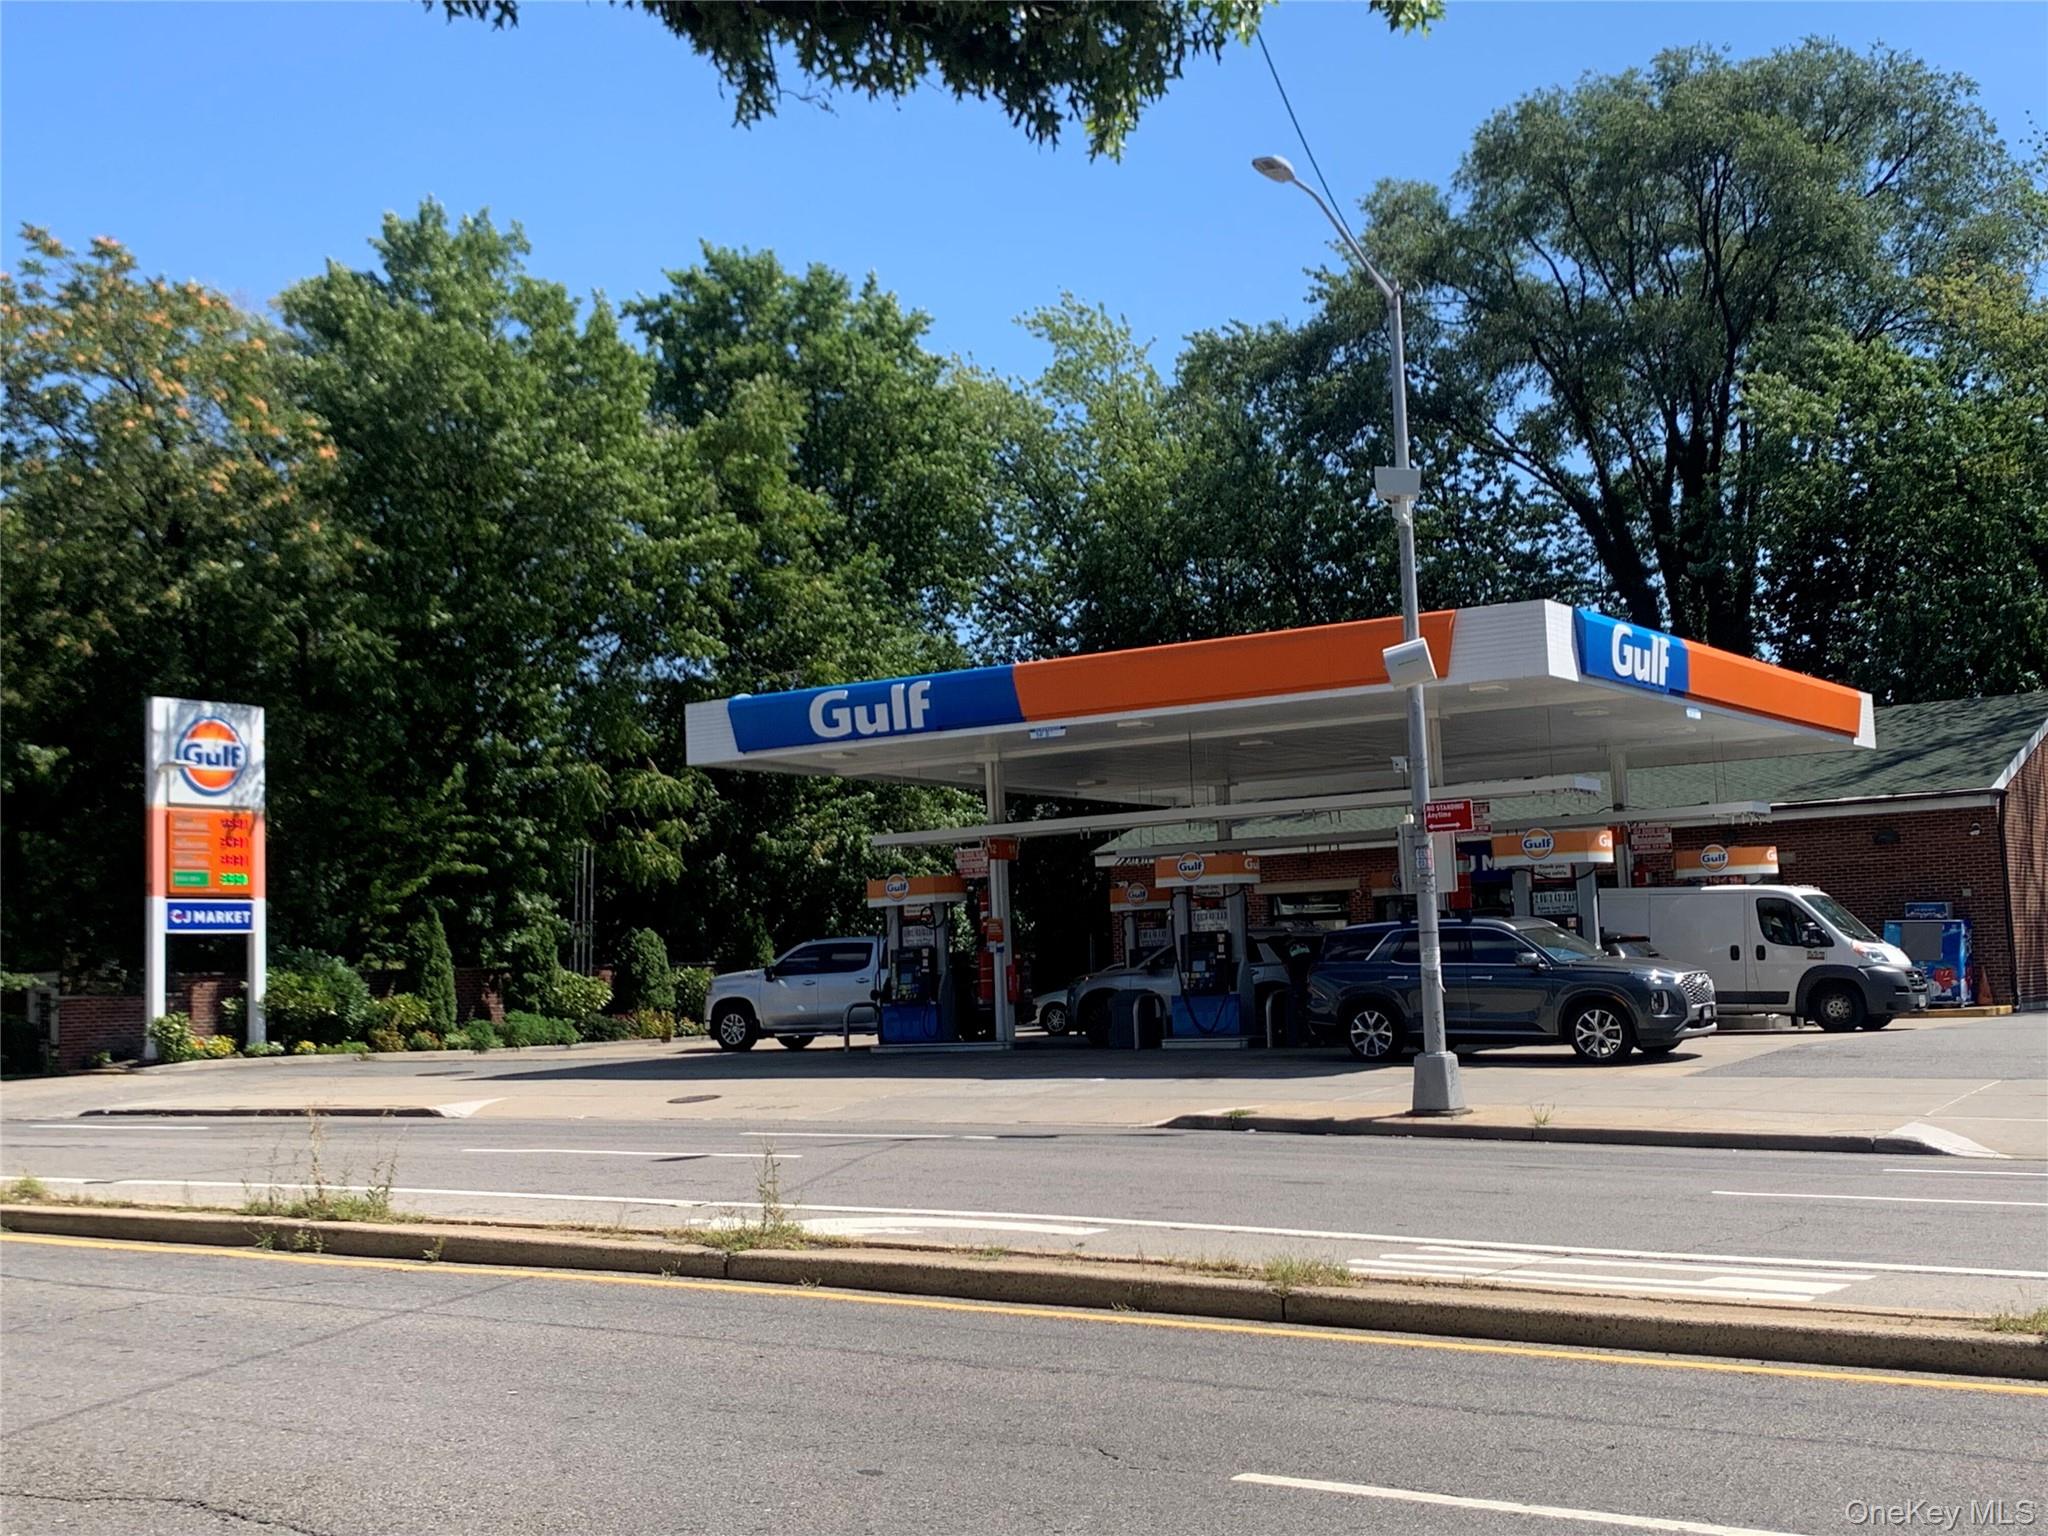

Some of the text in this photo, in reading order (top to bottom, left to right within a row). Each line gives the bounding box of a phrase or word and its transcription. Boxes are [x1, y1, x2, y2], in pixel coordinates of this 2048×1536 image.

[1611, 624, 1671, 687] Gulf
[808, 680, 931, 738] Gulf
[184, 743, 241, 767] Gulf
[1426, 804, 1435, 812] NO
[1436, 802, 1465, 811] STANDING
[1523, 839, 1552, 849] Gulf
[1702, 853, 1727, 863] Gulf
[1179, 861, 1202, 872] Gulf
[887, 882, 907, 892] Gulf
[1128, 890, 1146, 898] Gulf
[193, 910, 252, 924] MARKET
